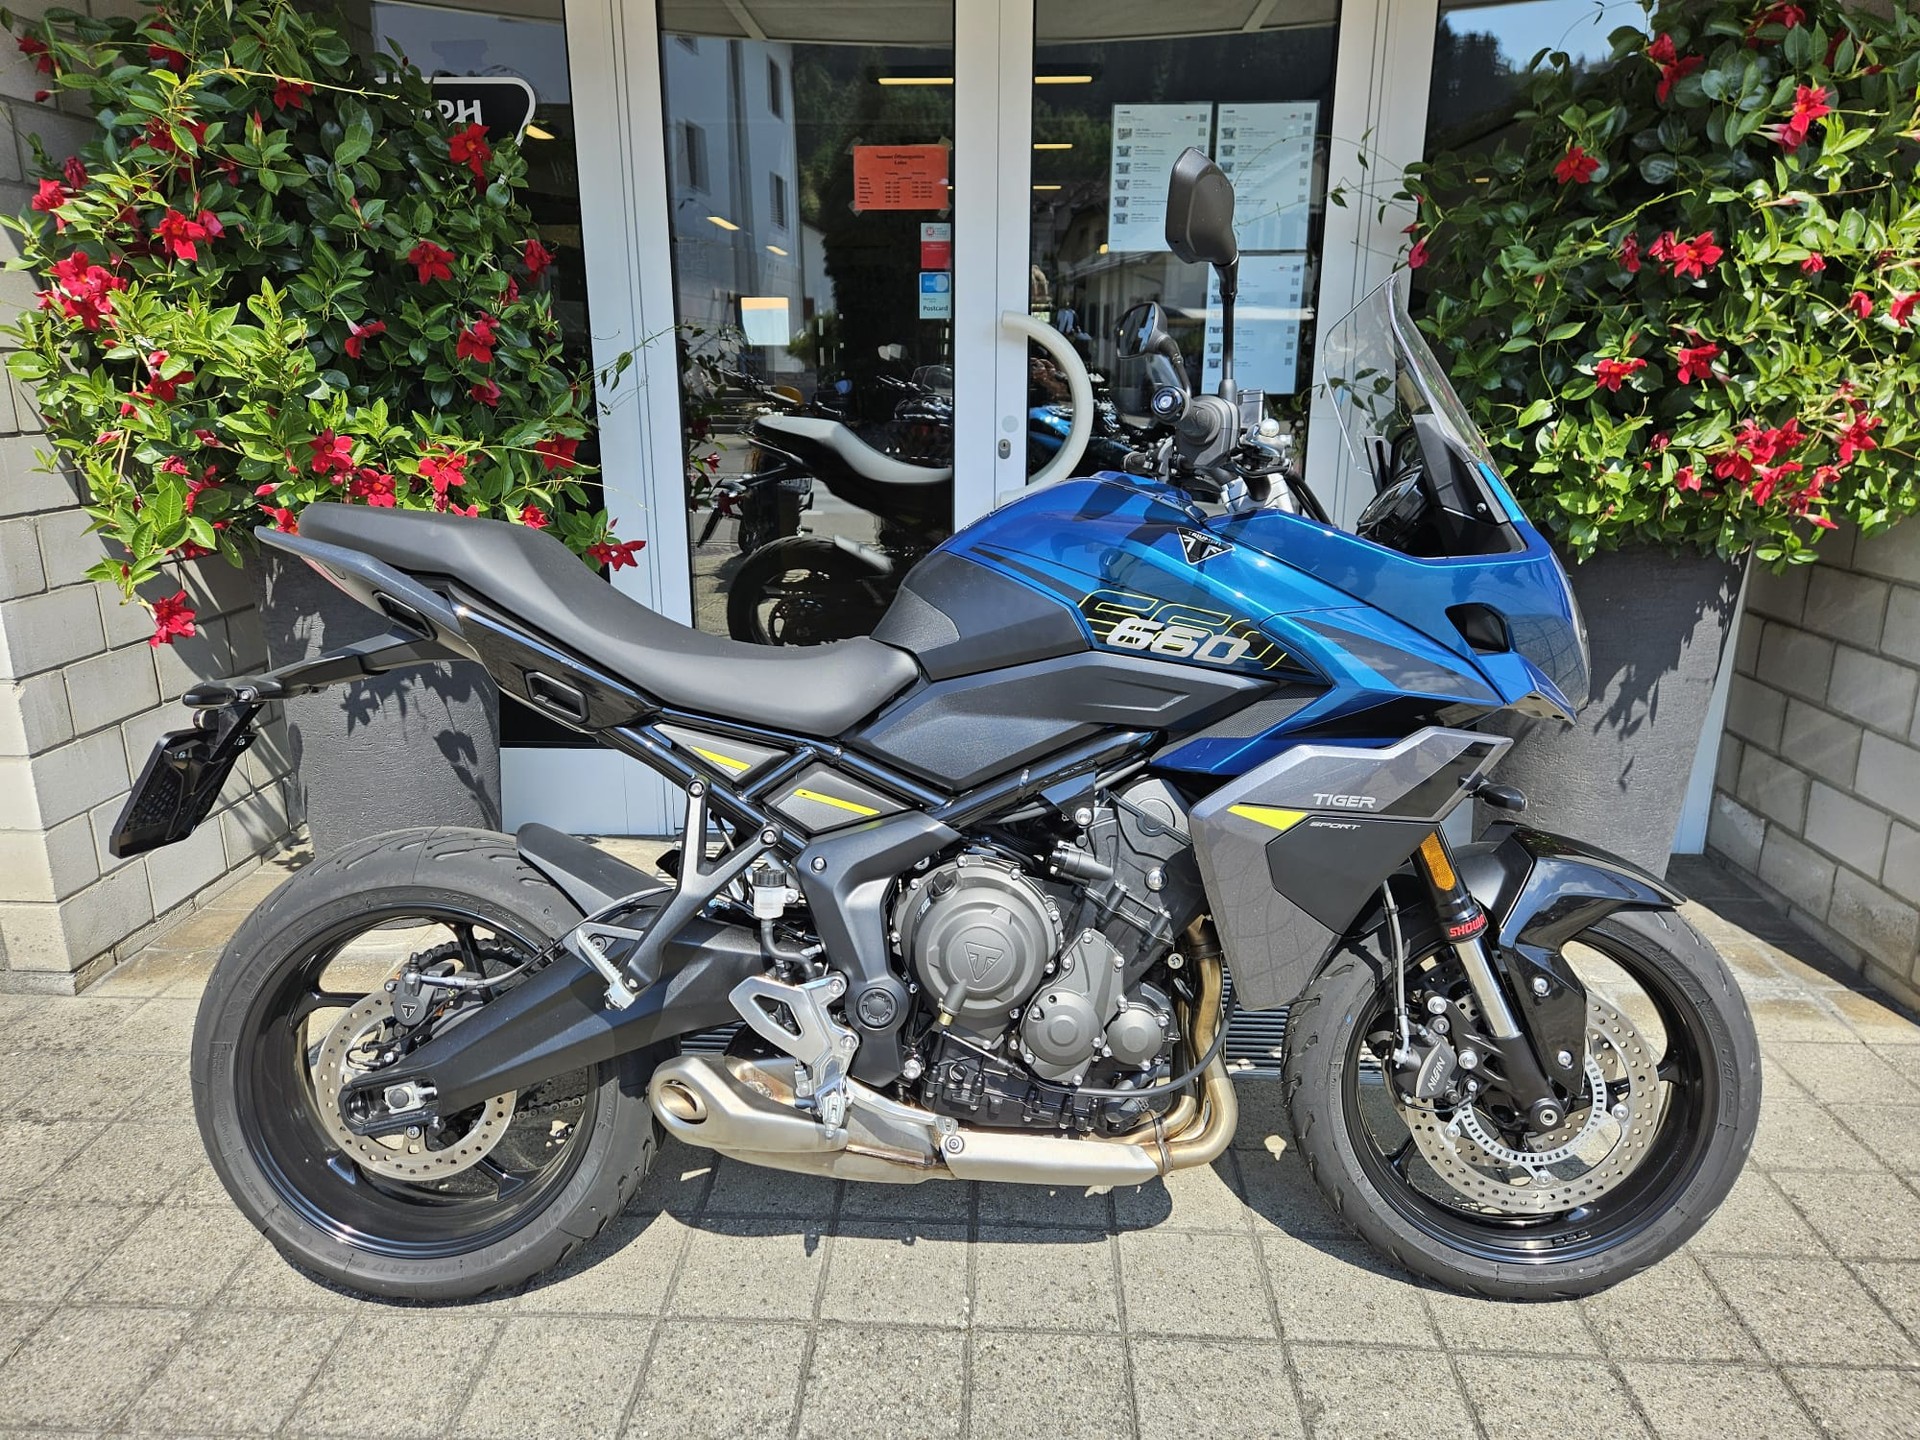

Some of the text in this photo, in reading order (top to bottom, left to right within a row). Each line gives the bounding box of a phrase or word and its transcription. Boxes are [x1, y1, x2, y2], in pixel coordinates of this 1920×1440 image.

[1106, 617, 1250, 665] 660
[1313, 793, 1377, 809] TIGER
[1309, 821, 1361, 830] SPORT
[1449, 913, 1486, 937] SHOWA
